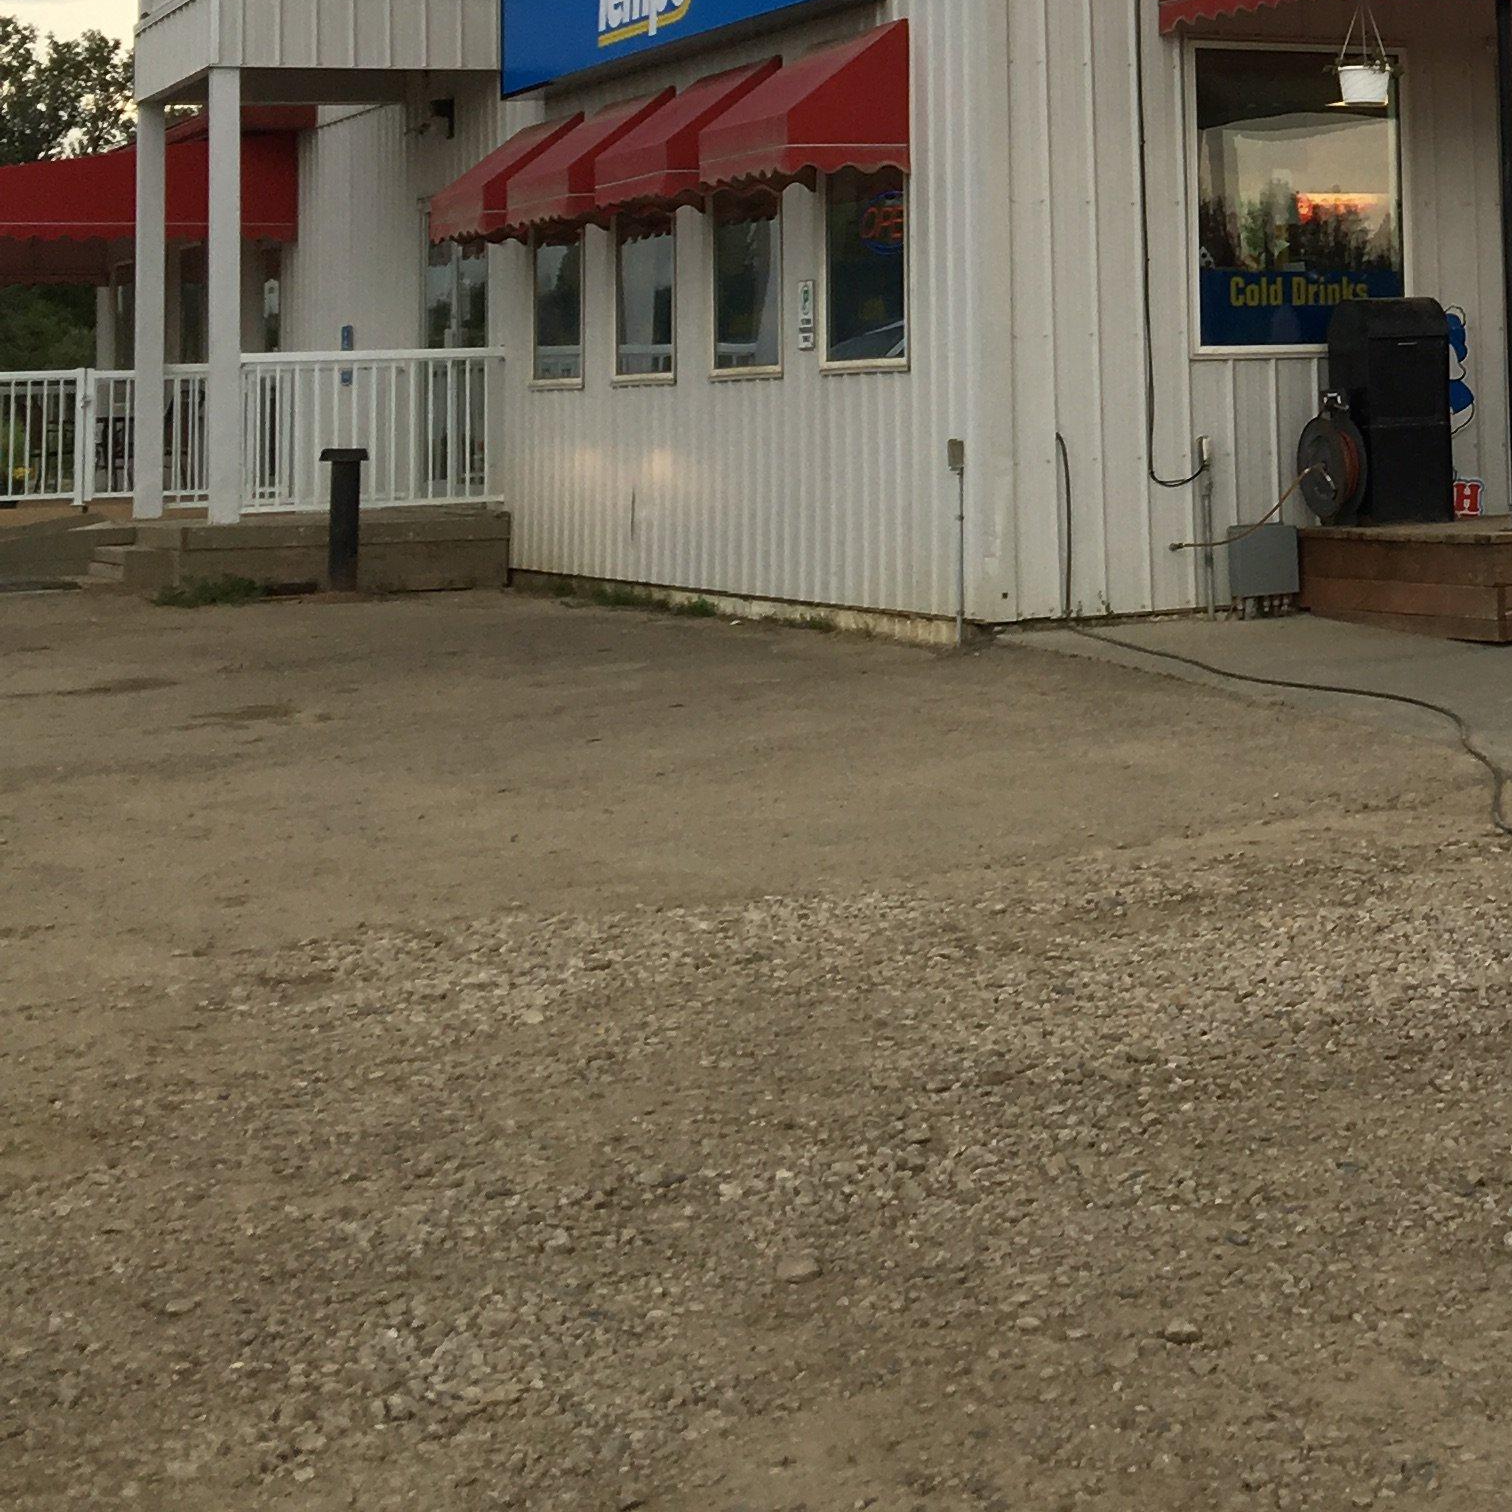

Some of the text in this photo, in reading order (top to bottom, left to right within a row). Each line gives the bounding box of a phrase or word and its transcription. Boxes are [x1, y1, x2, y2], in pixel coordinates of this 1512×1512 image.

[861, 206, 904, 239] OPE
[1230, 276, 1369, 307] Cold Drinks
